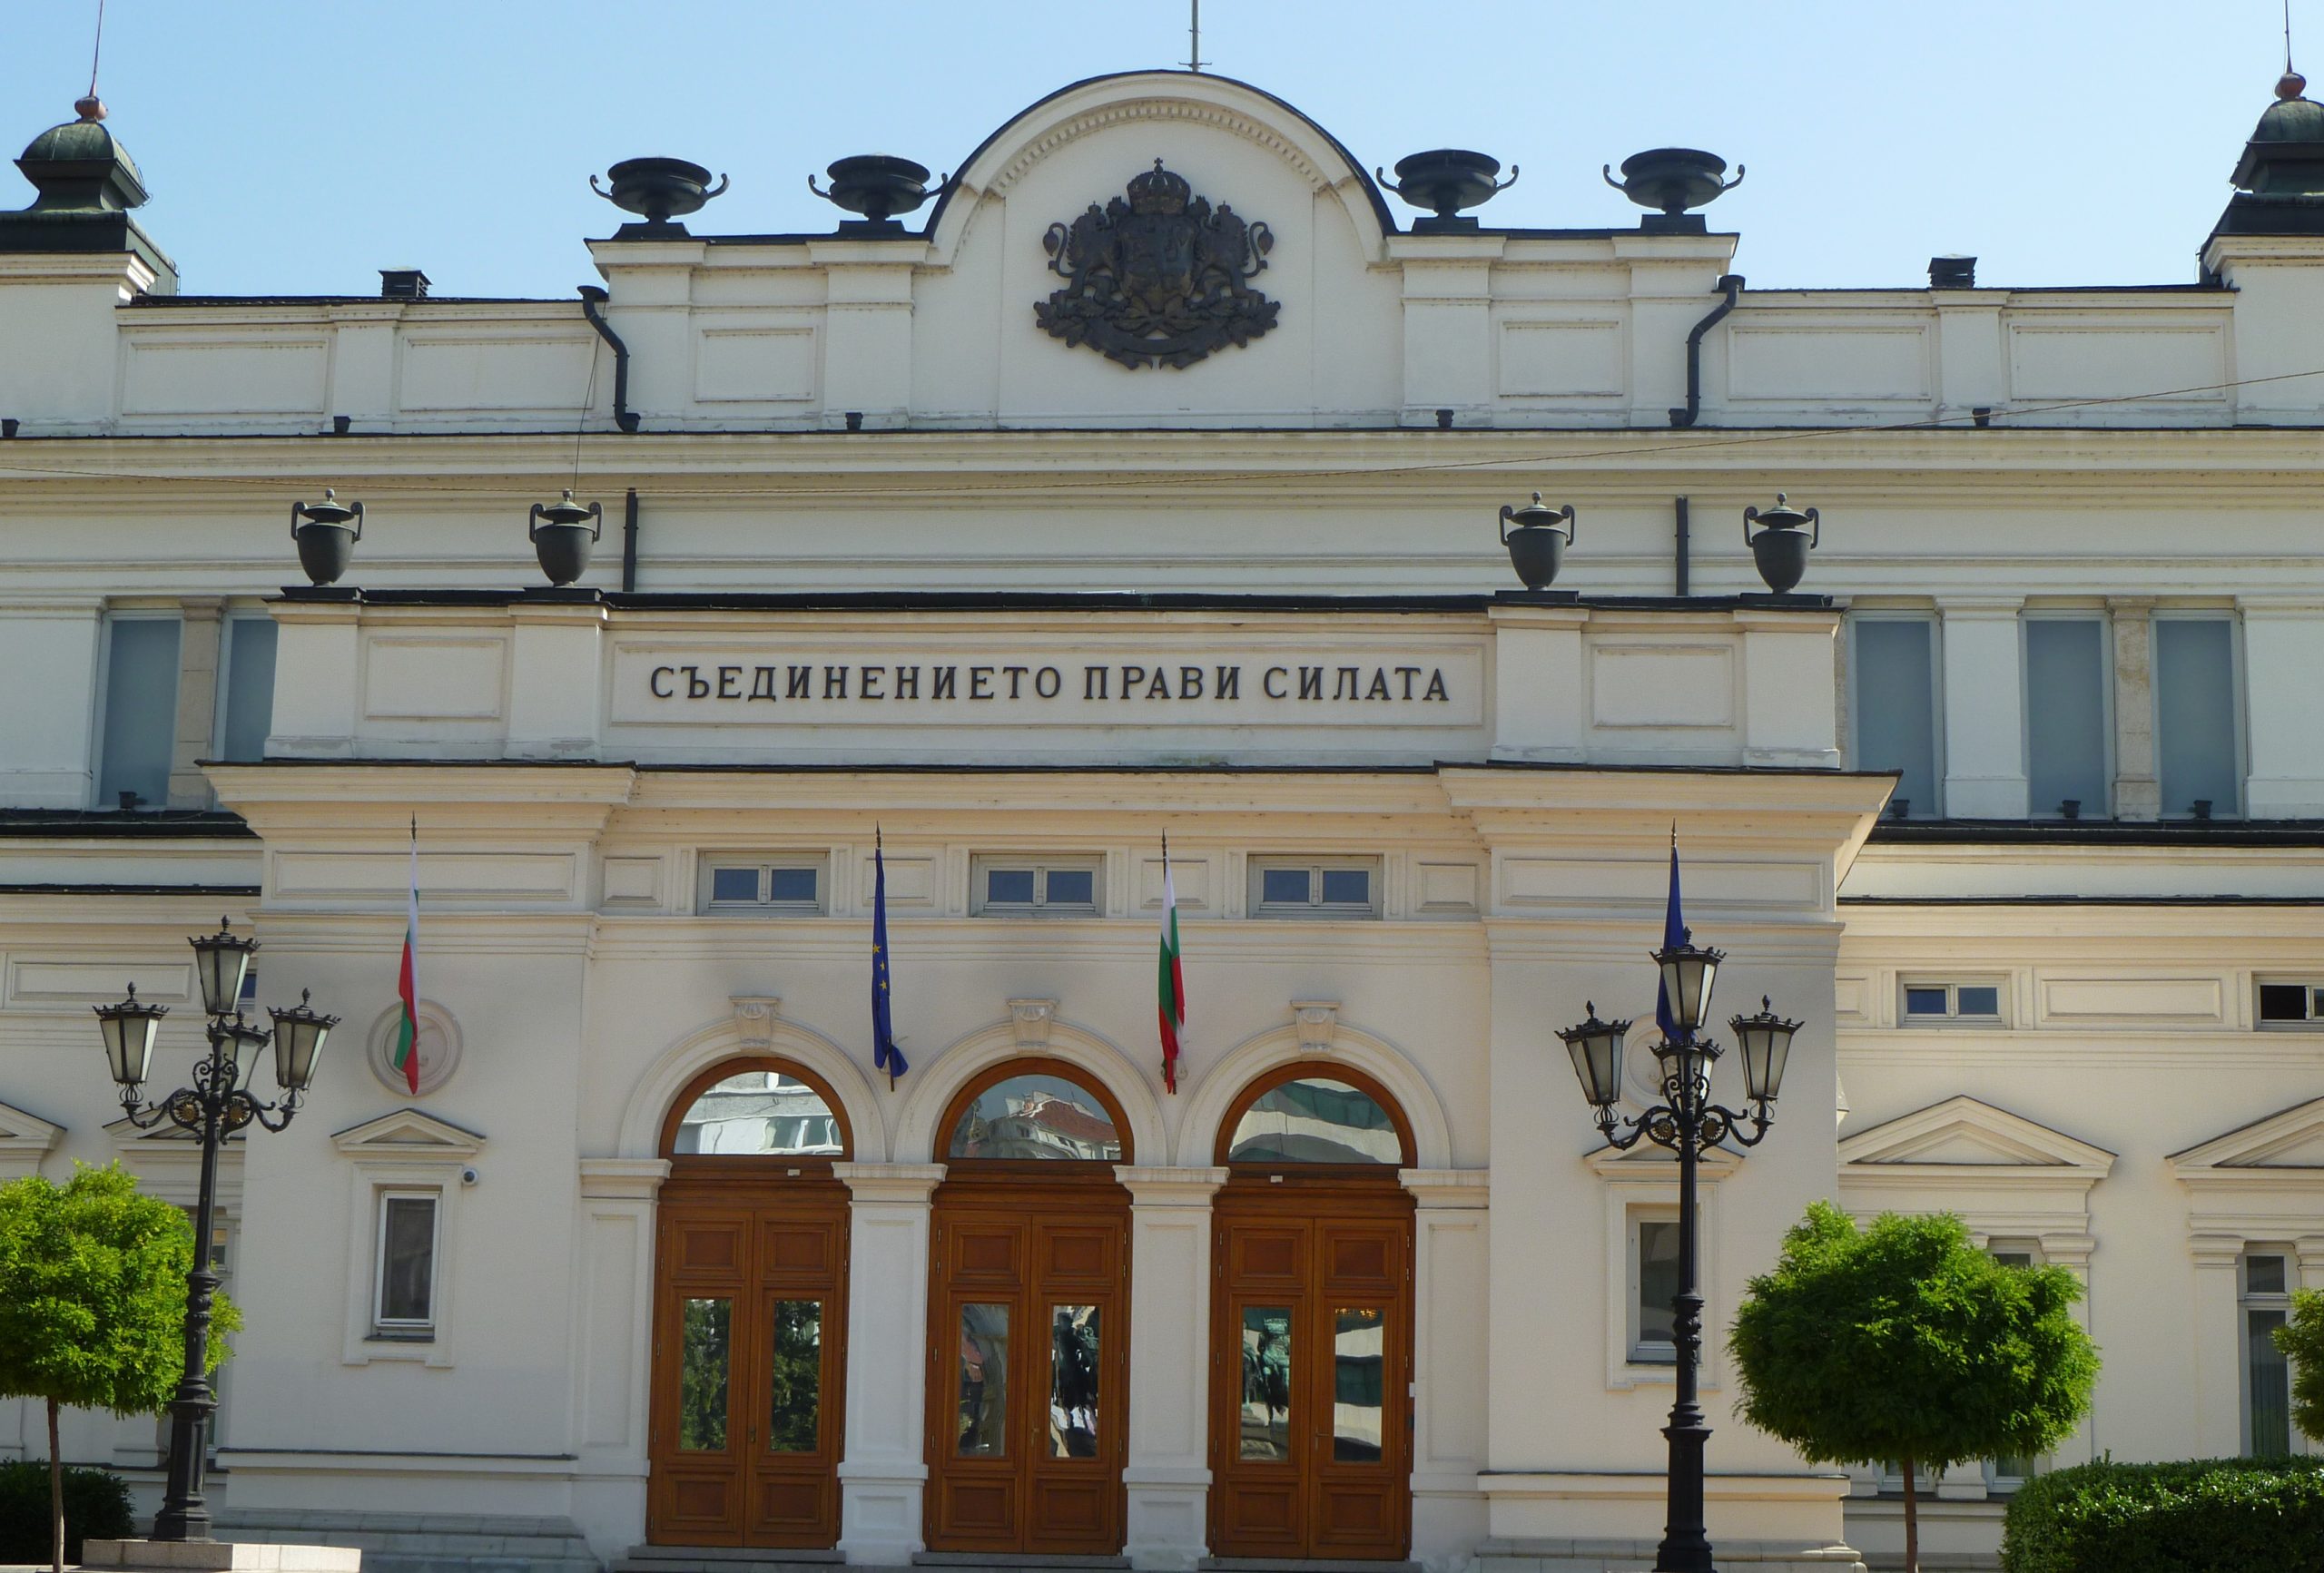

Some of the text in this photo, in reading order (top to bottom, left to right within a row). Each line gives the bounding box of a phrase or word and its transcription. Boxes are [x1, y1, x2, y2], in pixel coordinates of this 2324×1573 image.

[650, 665, 1450, 703] СЪЕДИНЕНИЕТО ПРАВИ СИЛАТА
